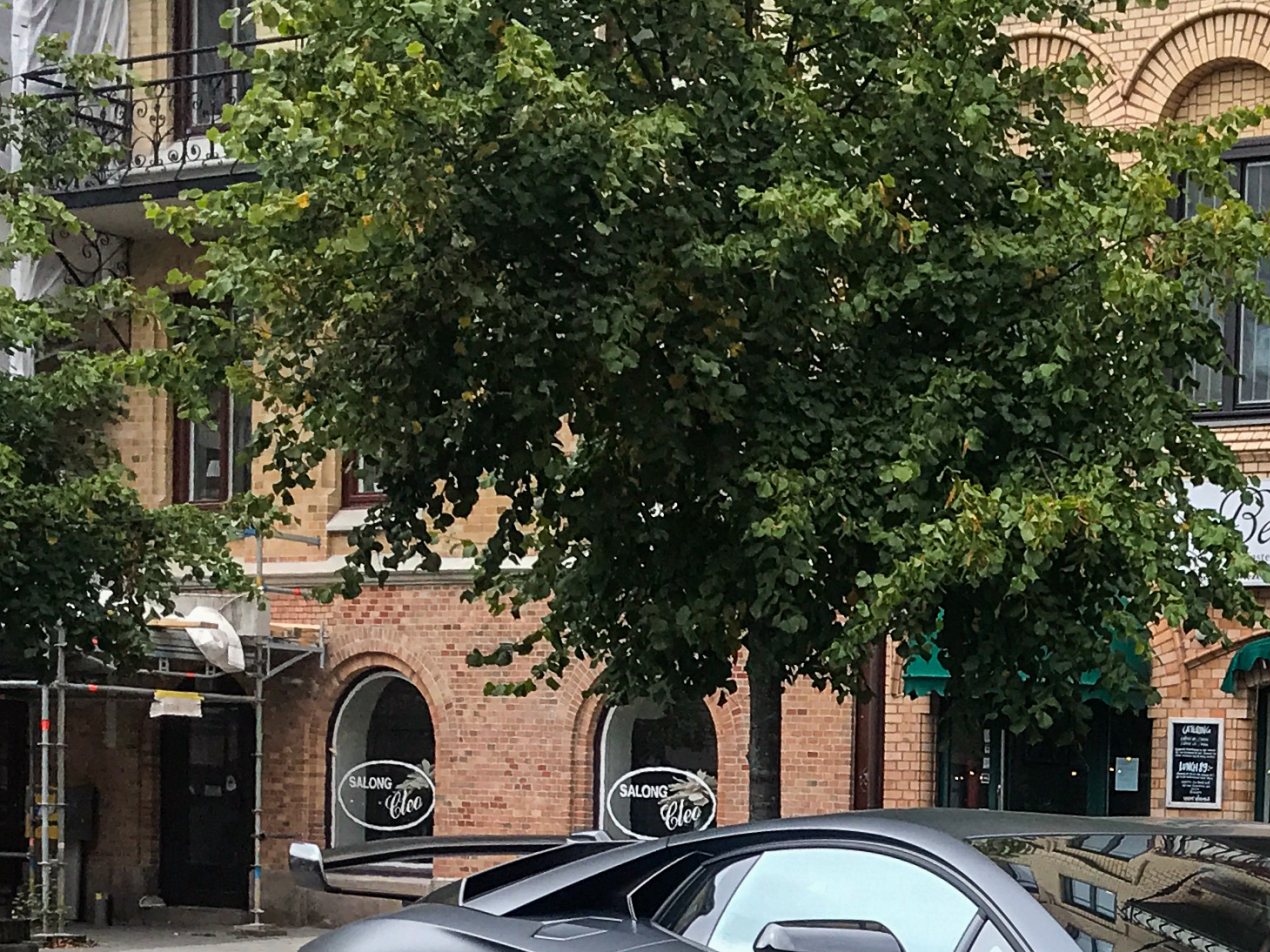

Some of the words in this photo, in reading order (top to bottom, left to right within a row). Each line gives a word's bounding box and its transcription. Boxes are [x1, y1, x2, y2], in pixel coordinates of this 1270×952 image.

[349, 776, 393, 790] SALONG
[619, 783, 669, 798] SALONG
[385, 789, 423, 819] Cleo
[660, 798, 702, 831] Cleo
